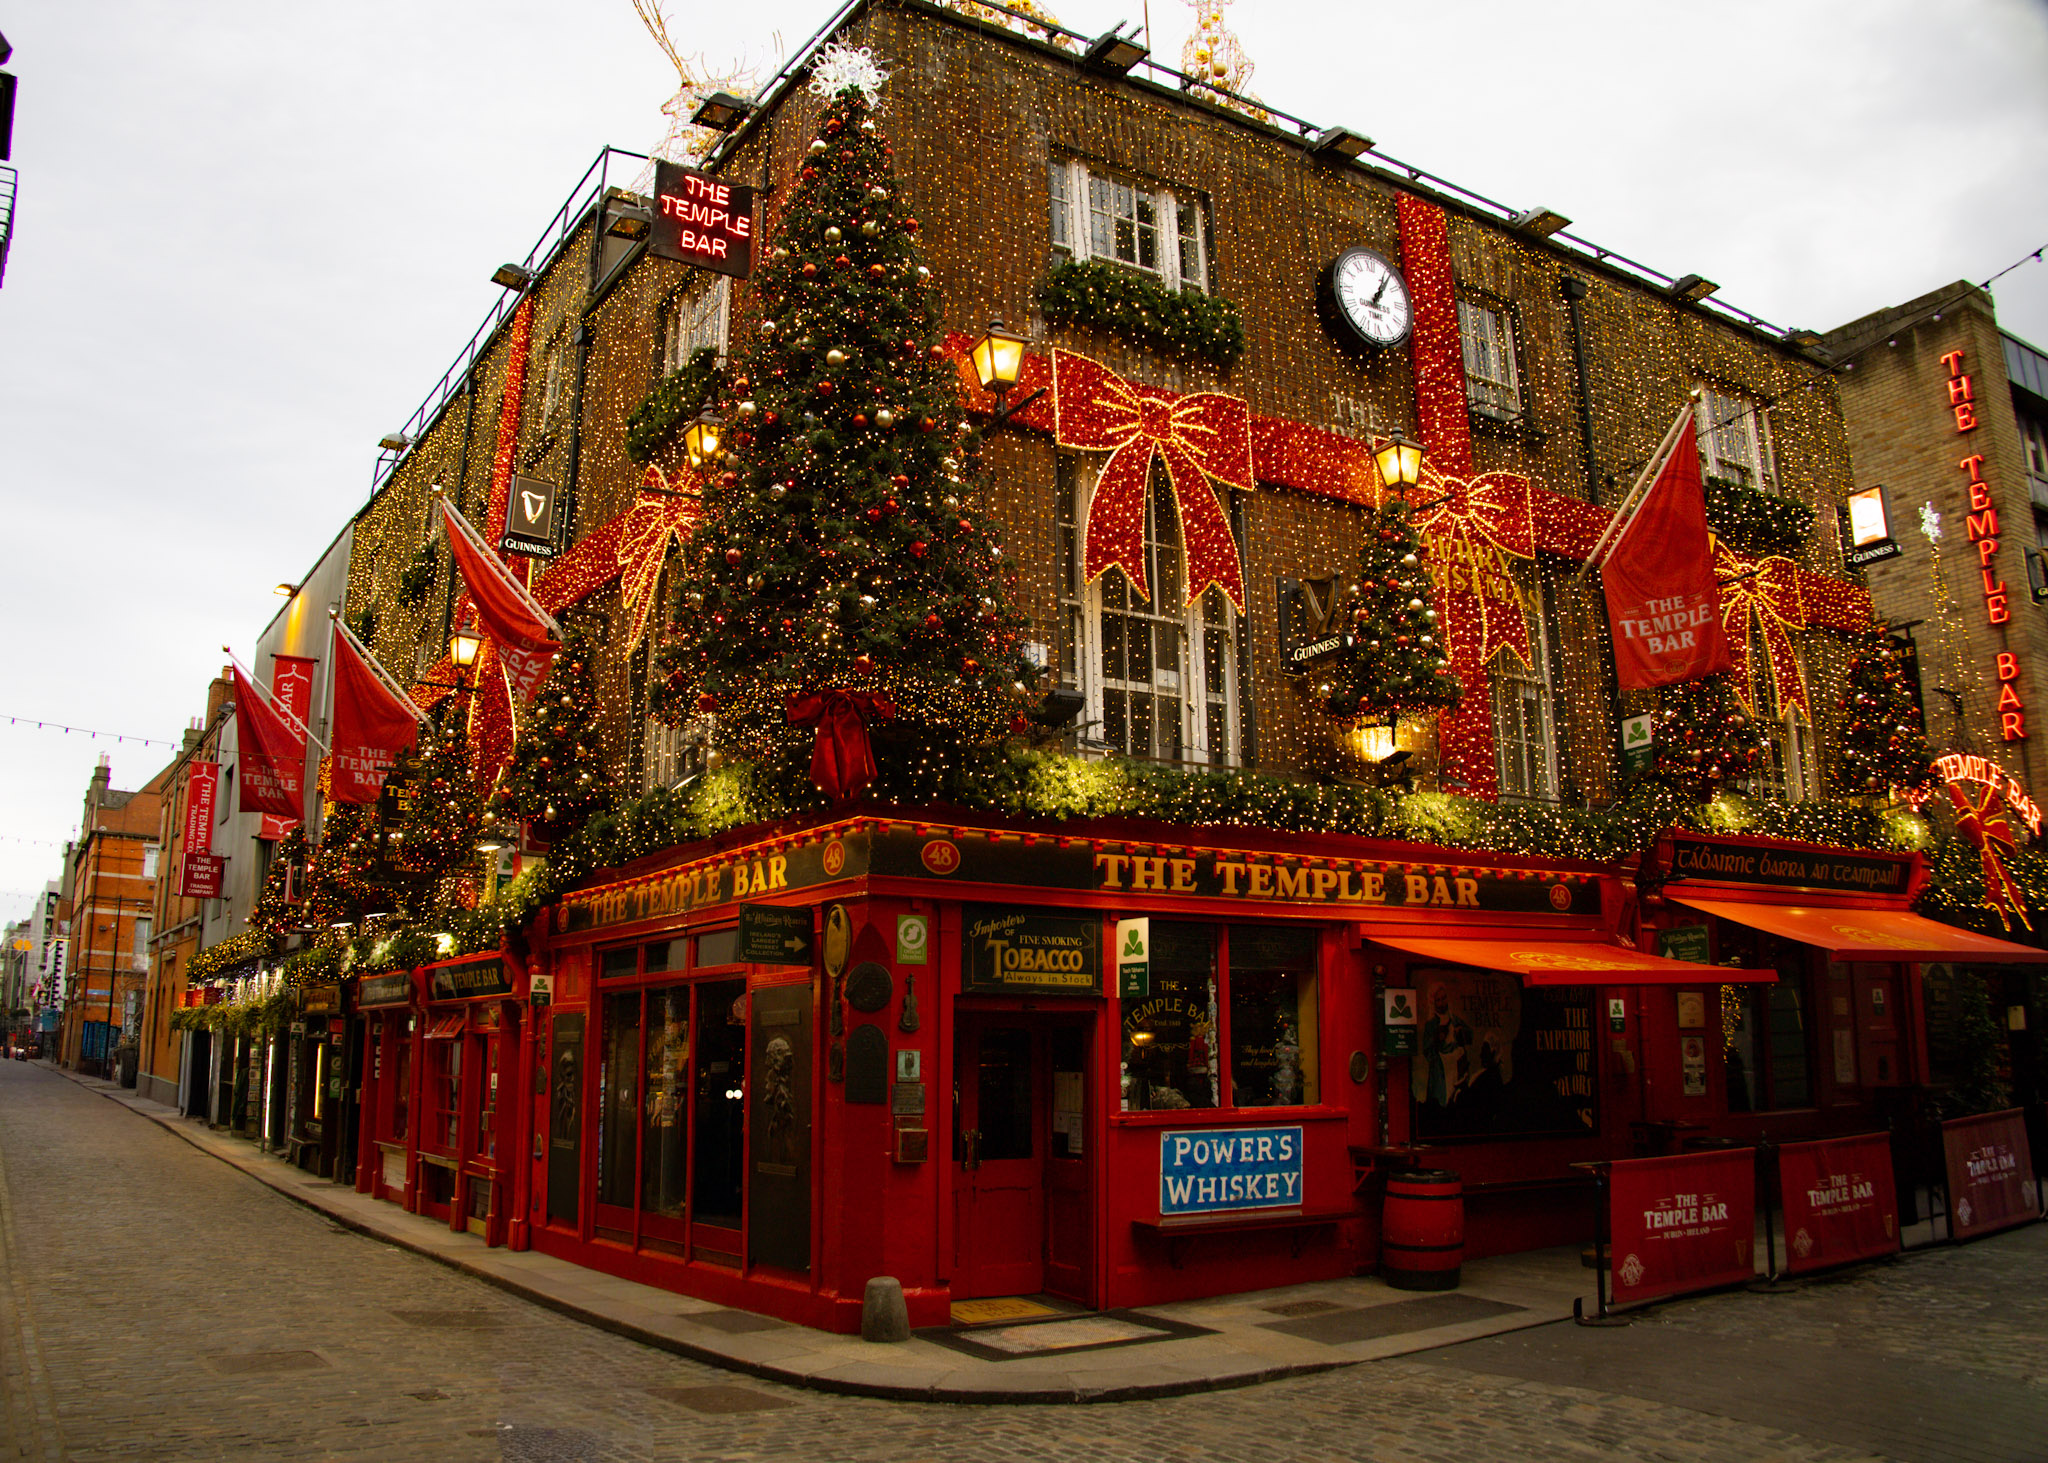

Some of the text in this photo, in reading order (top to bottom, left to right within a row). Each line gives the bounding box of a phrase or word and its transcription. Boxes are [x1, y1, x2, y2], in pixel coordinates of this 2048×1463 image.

[685, 175, 730, 206] THE
[660, 193, 750, 238] TEMPLE
[681, 230, 727, 259] BAR
[1368, 310, 1384, 322] TIME
[1940, 349, 1979, 432] THE
[504, 537, 553, 557] GUINNESS
[1960, 453, 2011, 626] TEMPLE
[1852, 543, 1895, 564] GUINNESS
[1645, 595, 1686, 615] THE
[1618, 603, 1713, 639] TEMPLE
[1293, 636, 1341, 662] GUINNESS
[1647, 630, 1697, 655] BAR
[516, 660, 545, 703] BAR
[1996, 651, 2029, 742] BAR
[358, 746, 388, 760] THE
[242, 773, 298, 792] TEMPLE
[260, 765, 281, 778] THE
[202, 782, 212, 805] THE
[258, 788, 285, 801] BAR
[1936, 753, 2042, 837] TEMPLE BAR
[188, 803, 198, 840] TRADING
[196, 857, 212, 865] THE
[826, 843, 844, 872] 48
[928, 843, 953, 867] 48
[188, 863, 219, 874] TEMPLE
[193, 872, 211, 881] BAR
[589, 855, 788, 927] THE TEMPLE BAR
[1096, 853, 1480, 908] THE TEMPLE BAR
[187, 888, 214, 896] COMPANY
[969, 914, 1026, 939] Importers
[1004, 928, 1015, 937] OF
[1019, 935, 1083, 947] FINE SMOKING
[454, 969, 482, 989] TEMPLE
[483, 967, 500, 986] BAR
[1005, 972, 1092, 985] Always in Stock
[1160, 980, 1180, 991] THE
[1123, 998, 1183, 1031] TEMPLE
[1563, 1008, 1589, 1028] THE
[1536, 1030, 1591, 1050] EMPEROR
[1576, 1052, 1591, 1072] OF
[1173, 1134, 1293, 1166] POWER'S
[1165, 1171, 1300, 1205] WHISKEY
[1830, 1175, 1849, 1187] THE
[1675, 1194, 1698, 1208] THE
[1807, 1181, 1875, 1208] TEMPLE BAR
[1644, 1203, 1729, 1229] TEMPLE BAR
[1663, 1226, 1710, 1240] DUBLIN IRELAND
